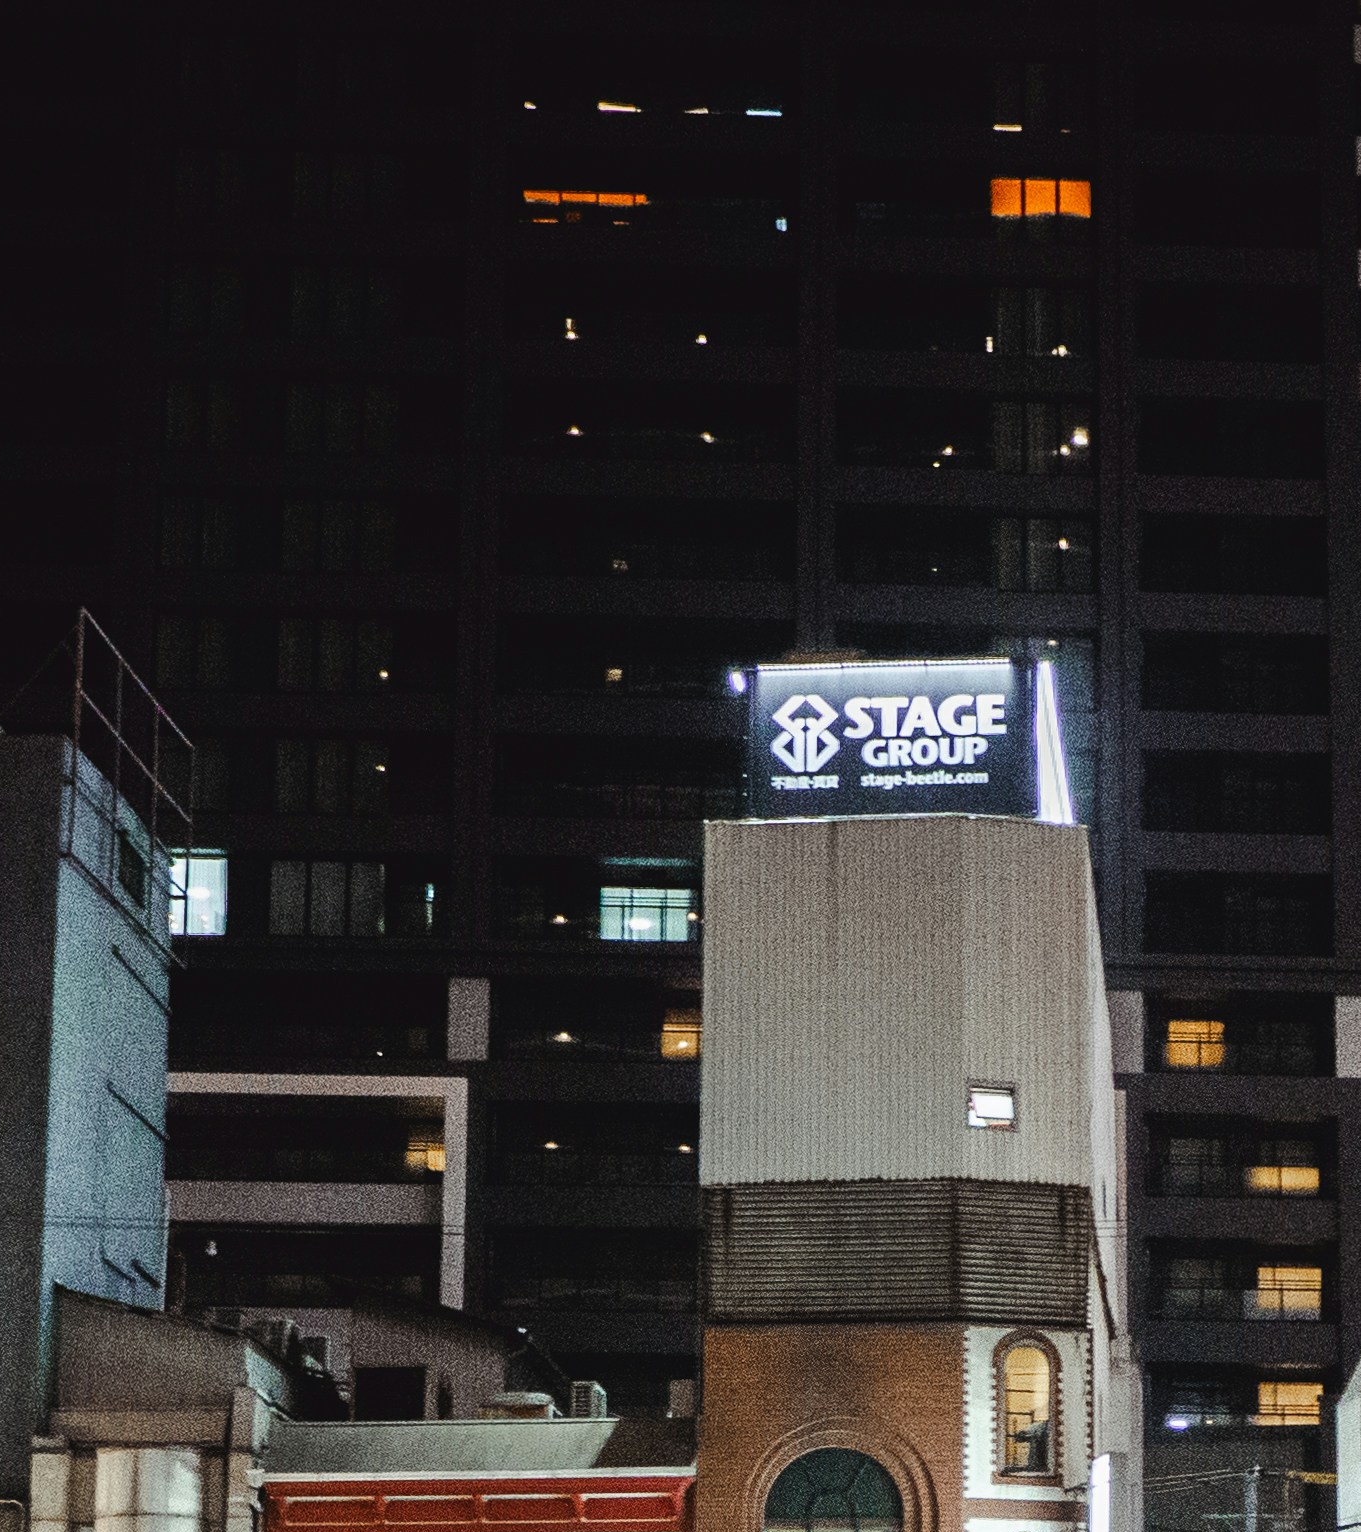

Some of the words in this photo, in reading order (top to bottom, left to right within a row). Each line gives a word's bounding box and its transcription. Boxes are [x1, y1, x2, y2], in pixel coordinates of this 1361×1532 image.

[843, 694, 1007, 738] STAGE
[861, 737, 988, 767] GROUP
[861, 770, 988, 789] stage-beetle.com
